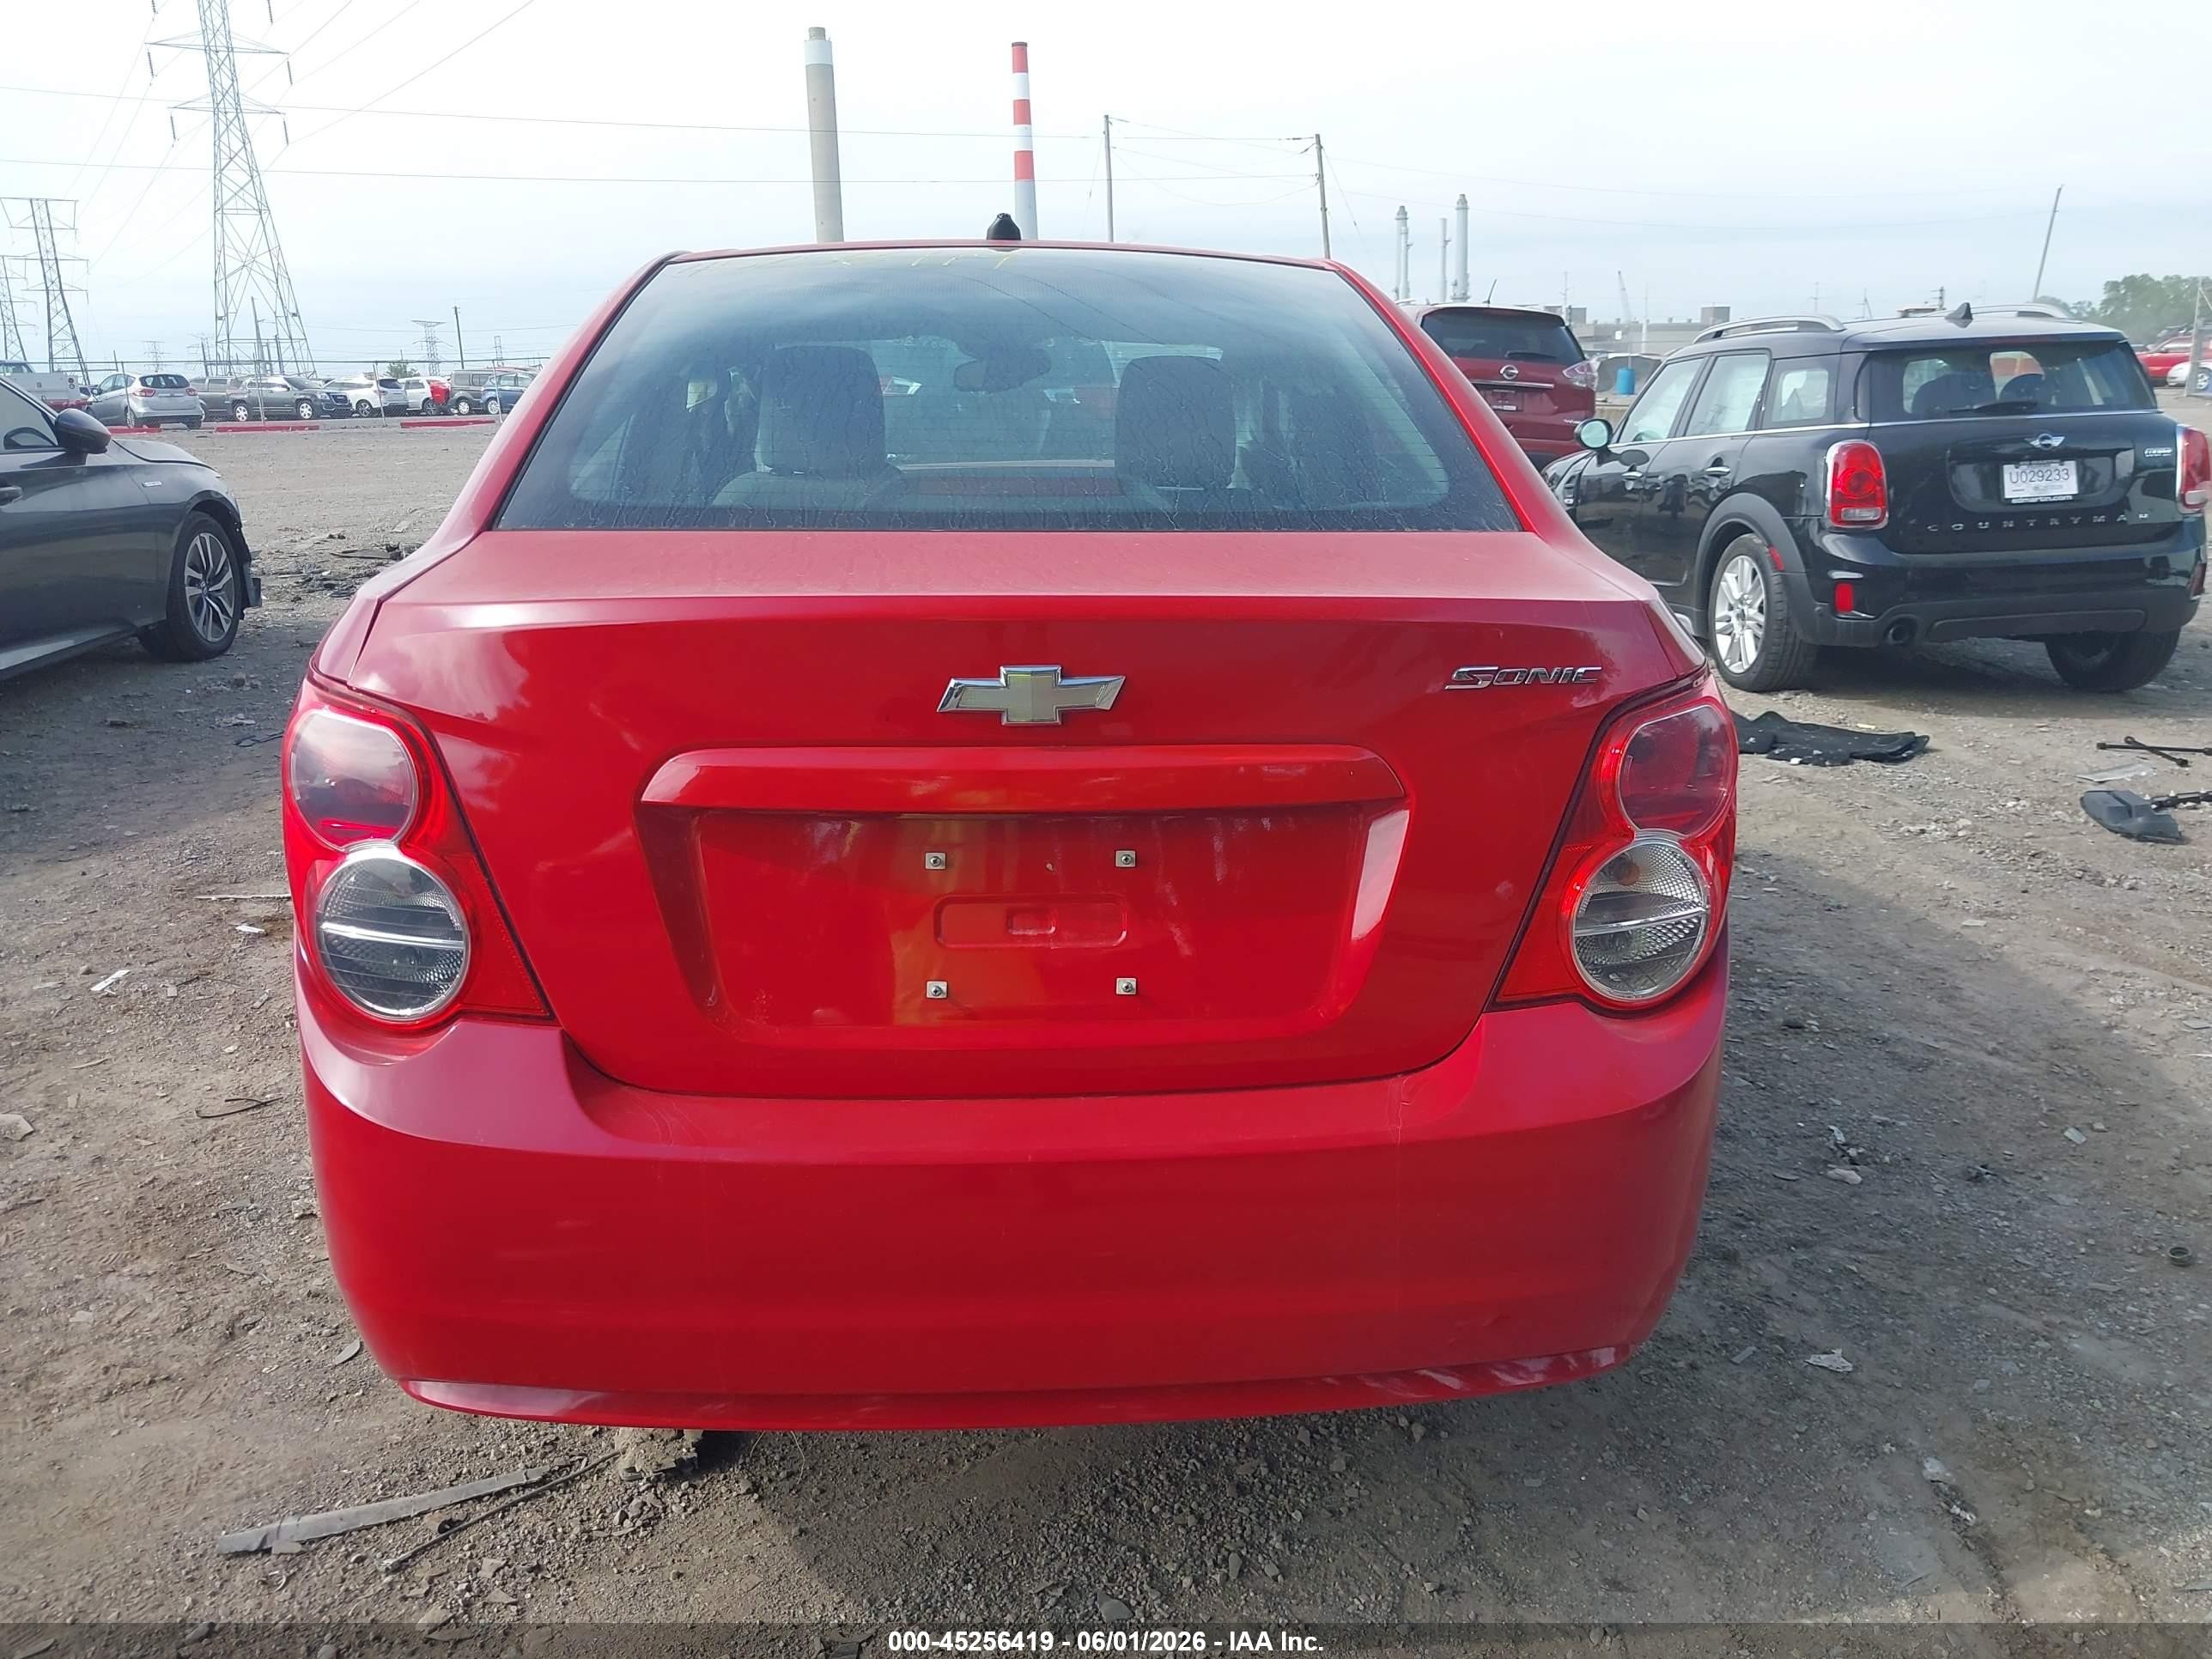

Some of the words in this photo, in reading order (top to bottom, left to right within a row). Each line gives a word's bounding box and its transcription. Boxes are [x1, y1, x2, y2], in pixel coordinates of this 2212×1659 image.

[2009, 468, 2069, 483] U029233
[1927, 514, 2148, 532] COUNTRYMAN
[1445, 665, 1602, 690] SONIC
